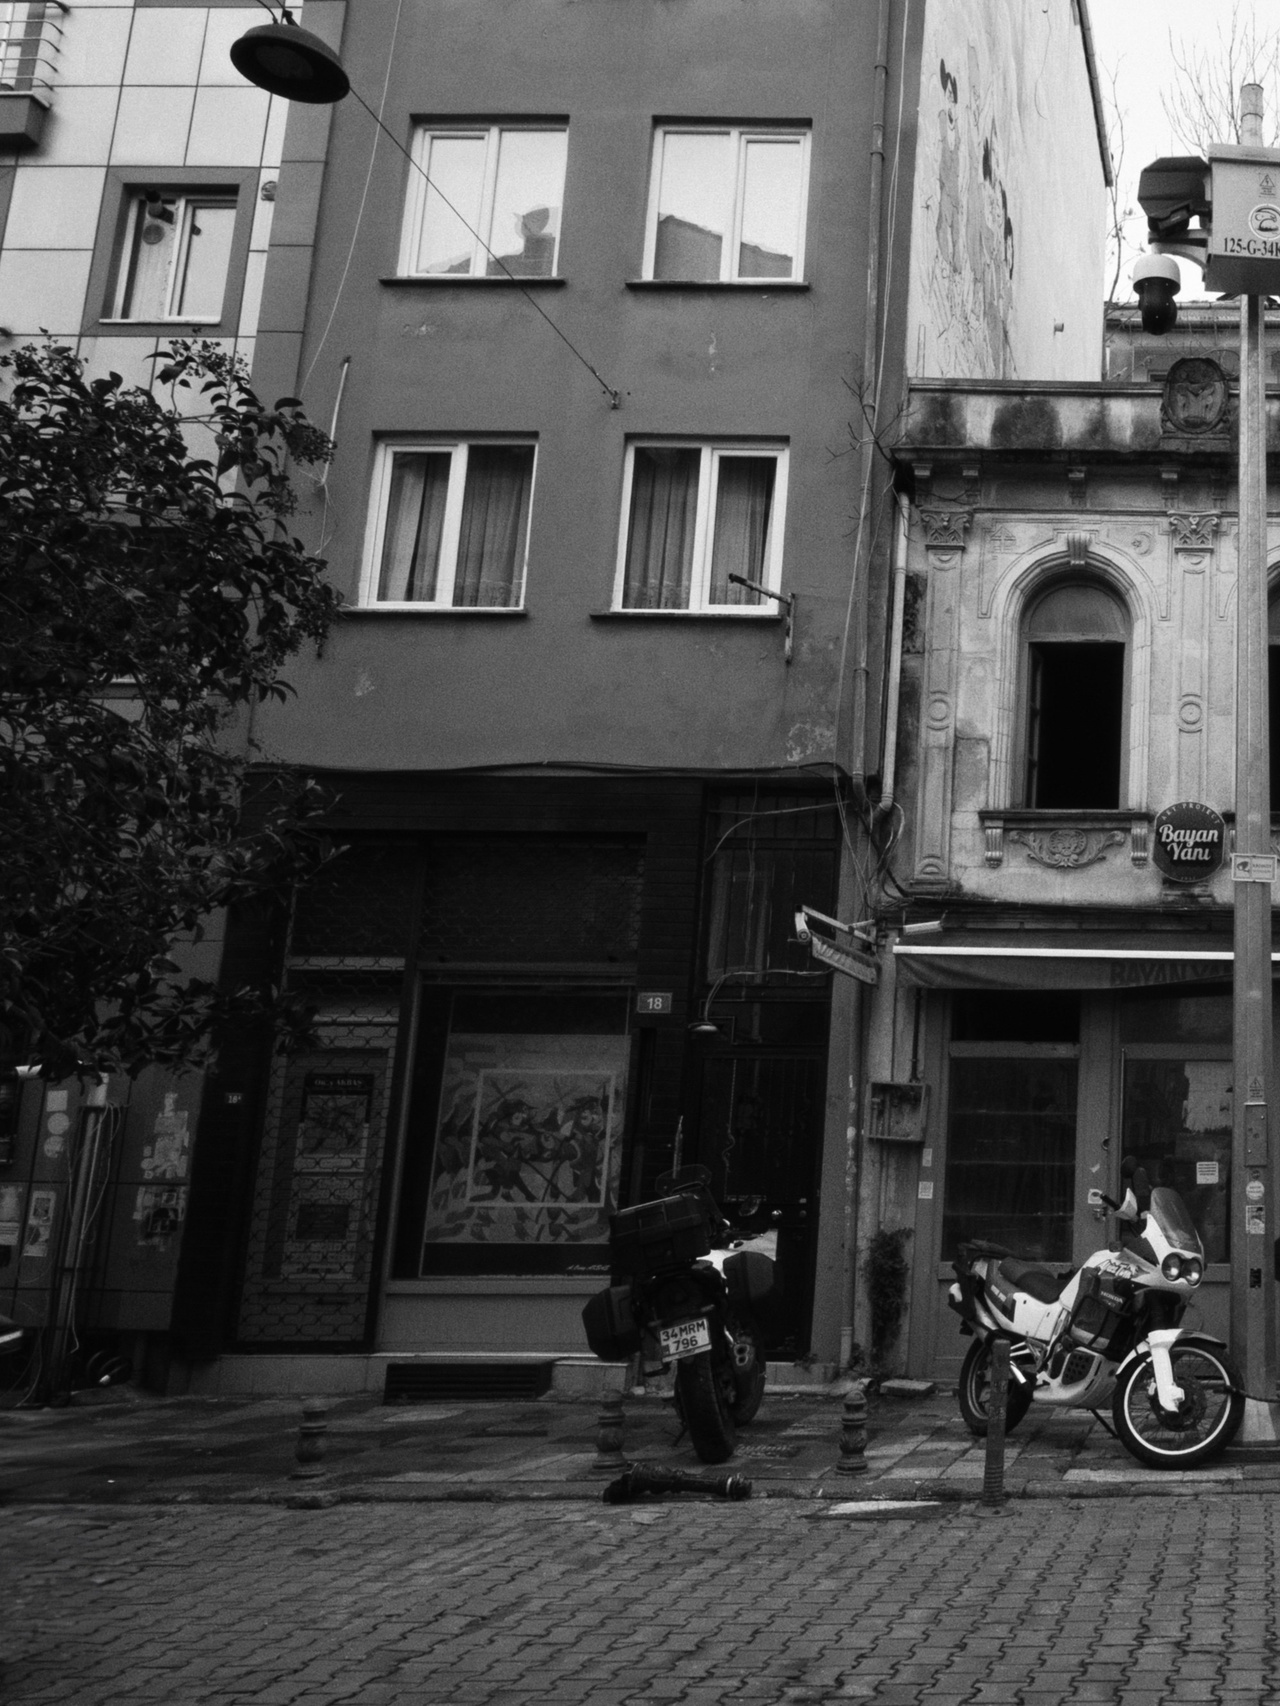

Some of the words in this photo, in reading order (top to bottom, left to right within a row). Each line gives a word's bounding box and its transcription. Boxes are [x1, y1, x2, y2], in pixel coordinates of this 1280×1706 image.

[1159, 824, 1219, 847] Bayan
[646, 996, 662, 1010] 18
[674, 1335, 698, 1351] 796
